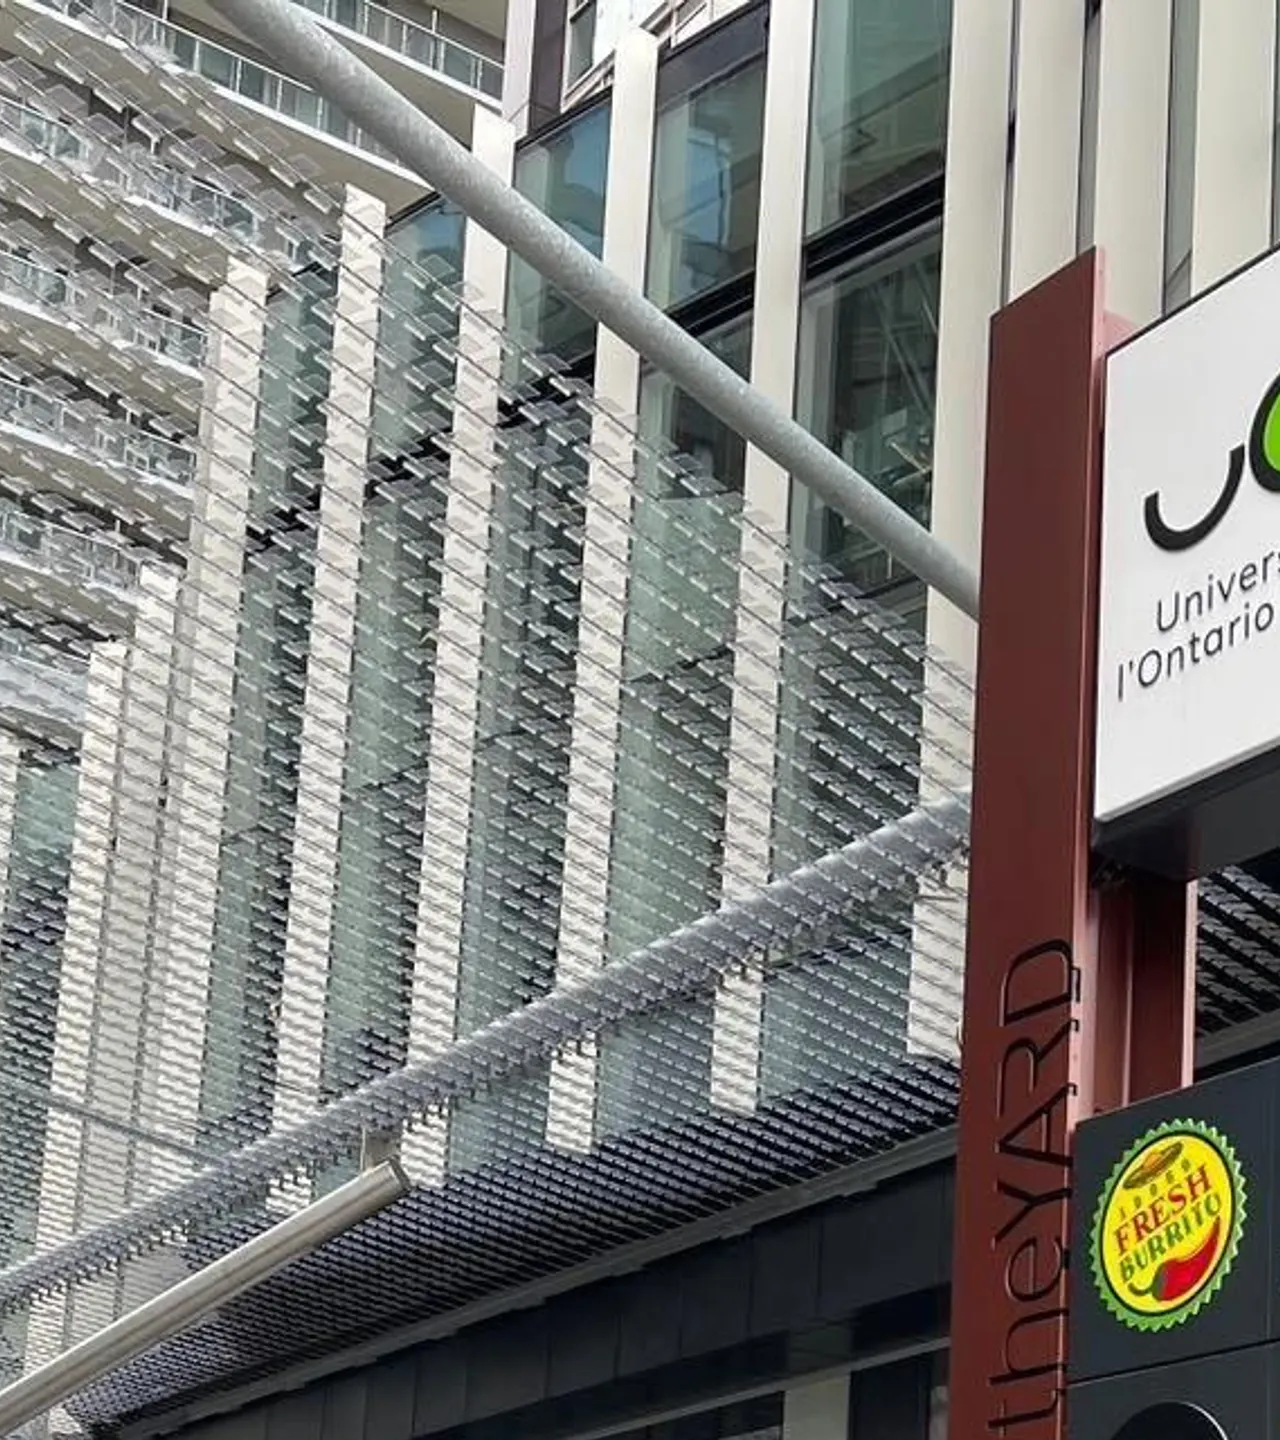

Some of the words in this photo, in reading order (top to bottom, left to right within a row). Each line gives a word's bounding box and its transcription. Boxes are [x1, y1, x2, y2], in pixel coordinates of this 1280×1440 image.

[1118, 602, 1275, 702] l'Ontario
[1114, 1164, 1212, 1256] FRESH
[1119, 1192, 1222, 1283] BURRITO
